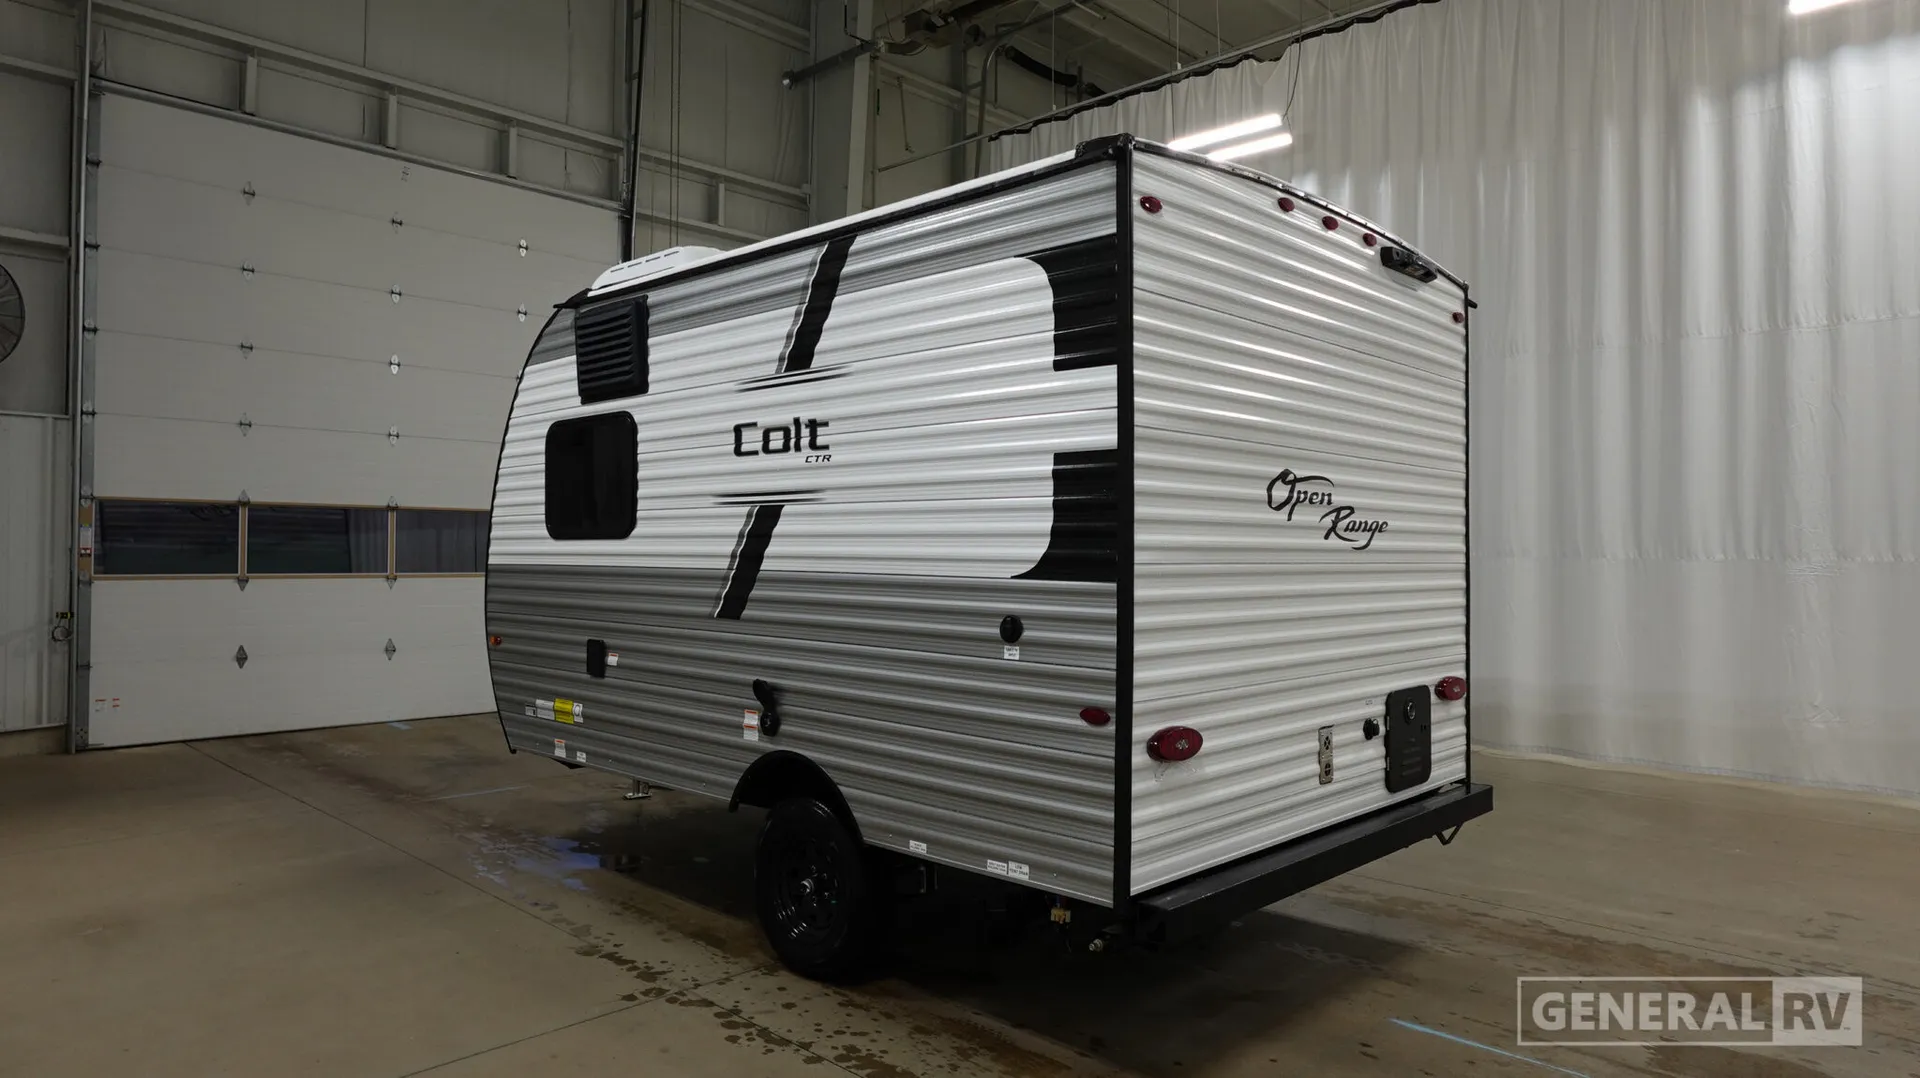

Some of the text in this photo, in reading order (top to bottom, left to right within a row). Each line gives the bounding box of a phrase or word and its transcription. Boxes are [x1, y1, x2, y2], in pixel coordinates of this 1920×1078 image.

[733, 416, 830, 457] Colt
[804, 454, 832, 463] CTR
[1266, 468, 1335, 521] Open
[1318, 505, 1389, 551] Range
